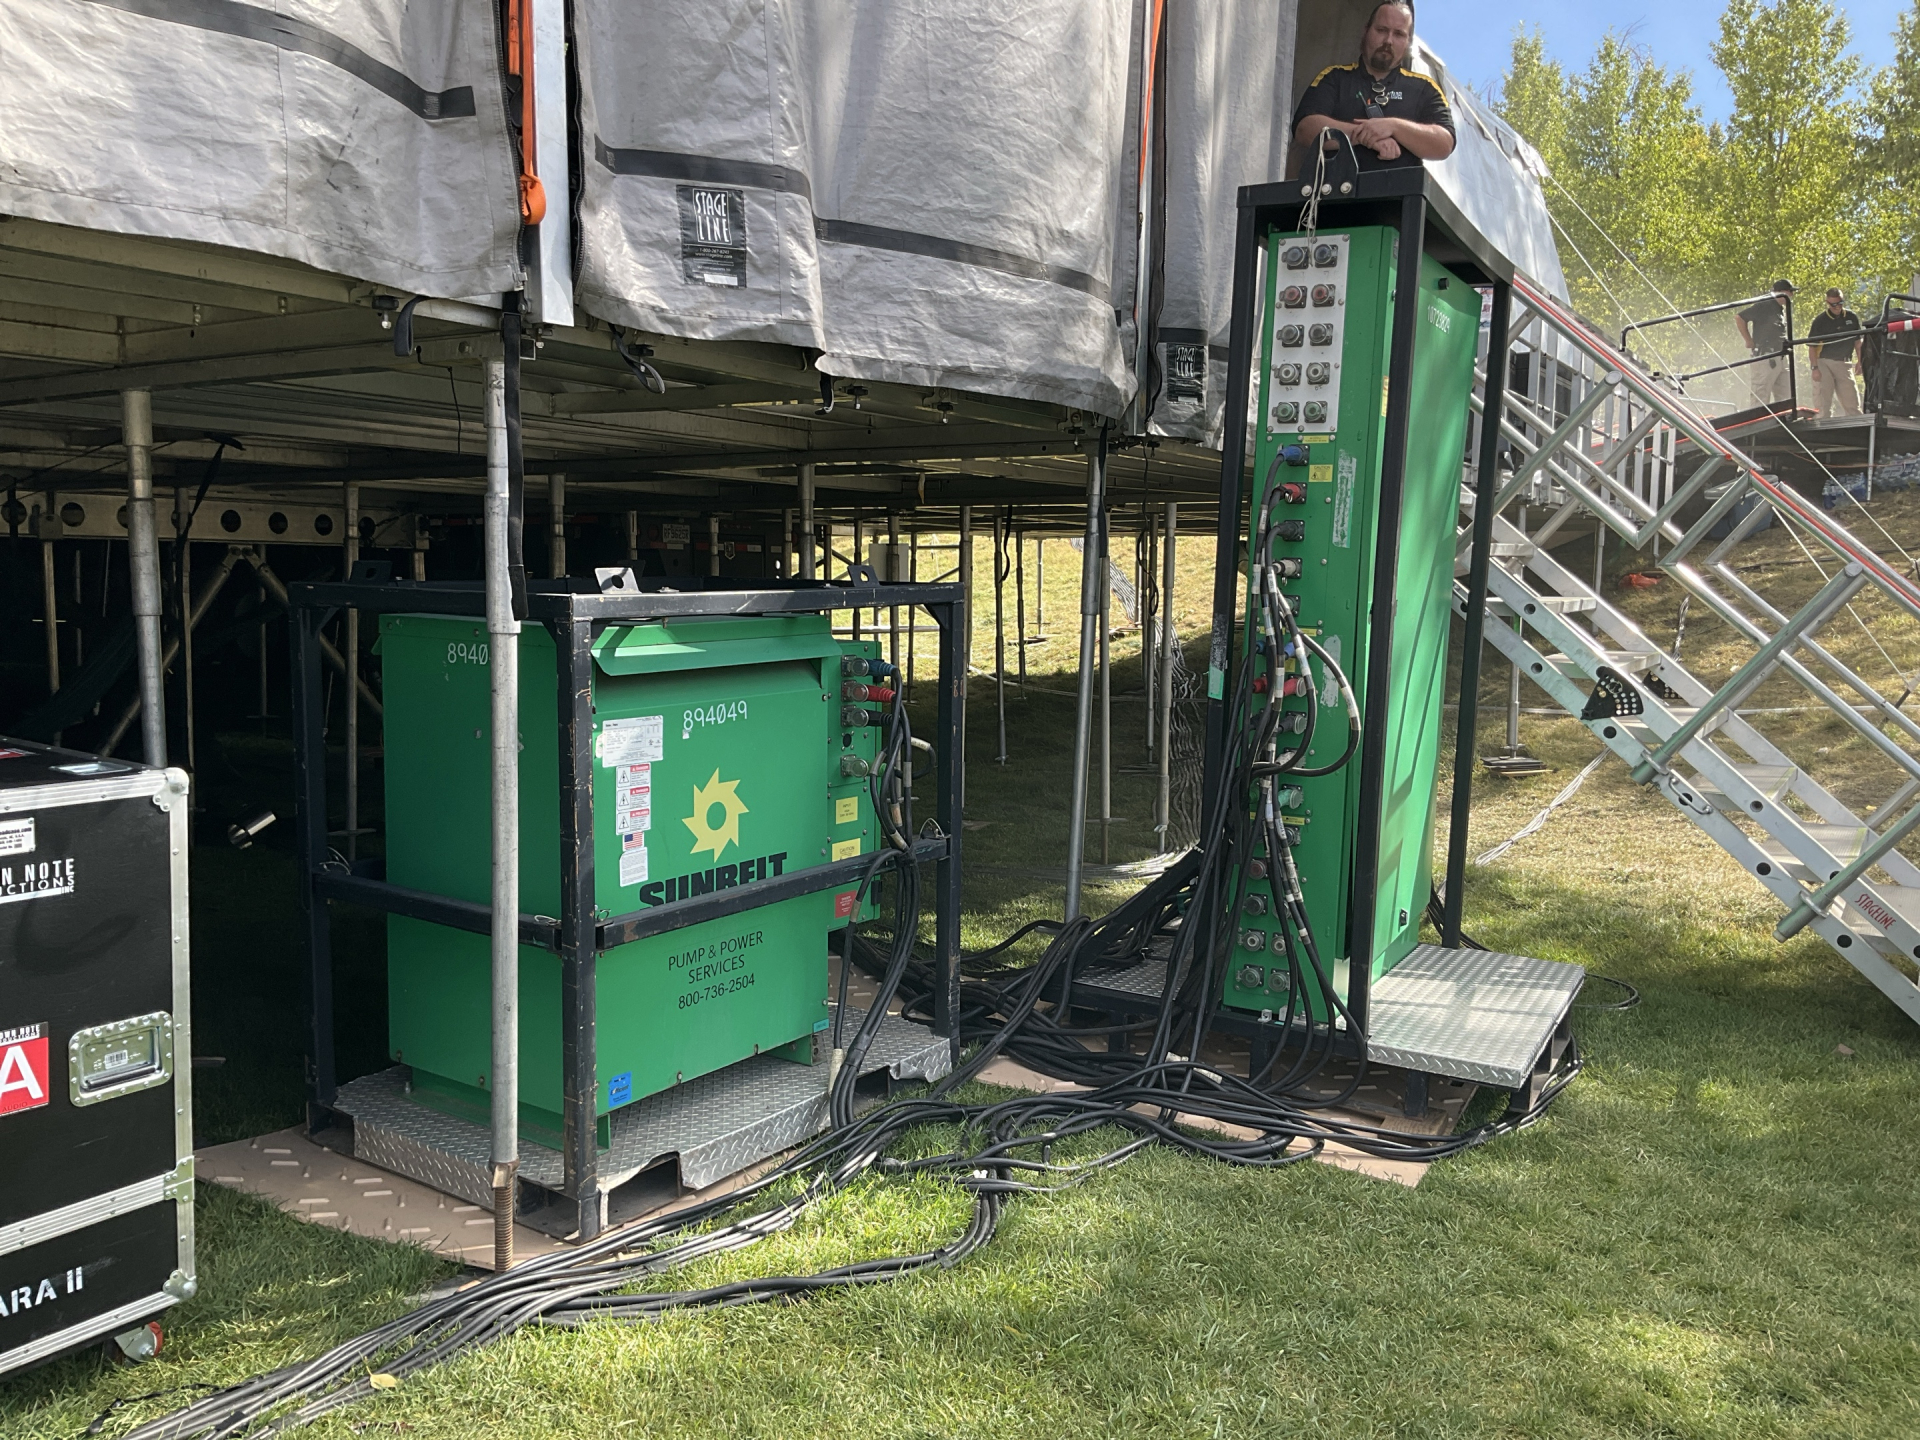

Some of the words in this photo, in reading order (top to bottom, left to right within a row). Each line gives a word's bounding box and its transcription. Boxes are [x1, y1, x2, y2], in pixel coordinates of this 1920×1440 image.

[695, 191, 727, 217] STAGE
[698, 215, 730, 243] LINE
[447, 643, 489, 665] 8940
[683, 700, 748, 731] 894049
[24, 858, 75, 883] NOTE
[639, 851, 788, 910] SUNBELT
[0, 875, 75, 896] CTIONS
[60, 885, 75, 894] INC
[1854, 893, 1897, 930] STAGELINE
[668, 947, 706, 971] PUMP
[708, 944, 717, 959] &
[720, 930, 764, 955] POWER
[688, 954, 745, 984] SERVICES
[678, 973, 755, 1010] 800-736-2504
[20, 1024, 40, 1036] NOTE
[0, 1045, 44, 1099] A
[2, 1101, 28, 1112] AUDIO
